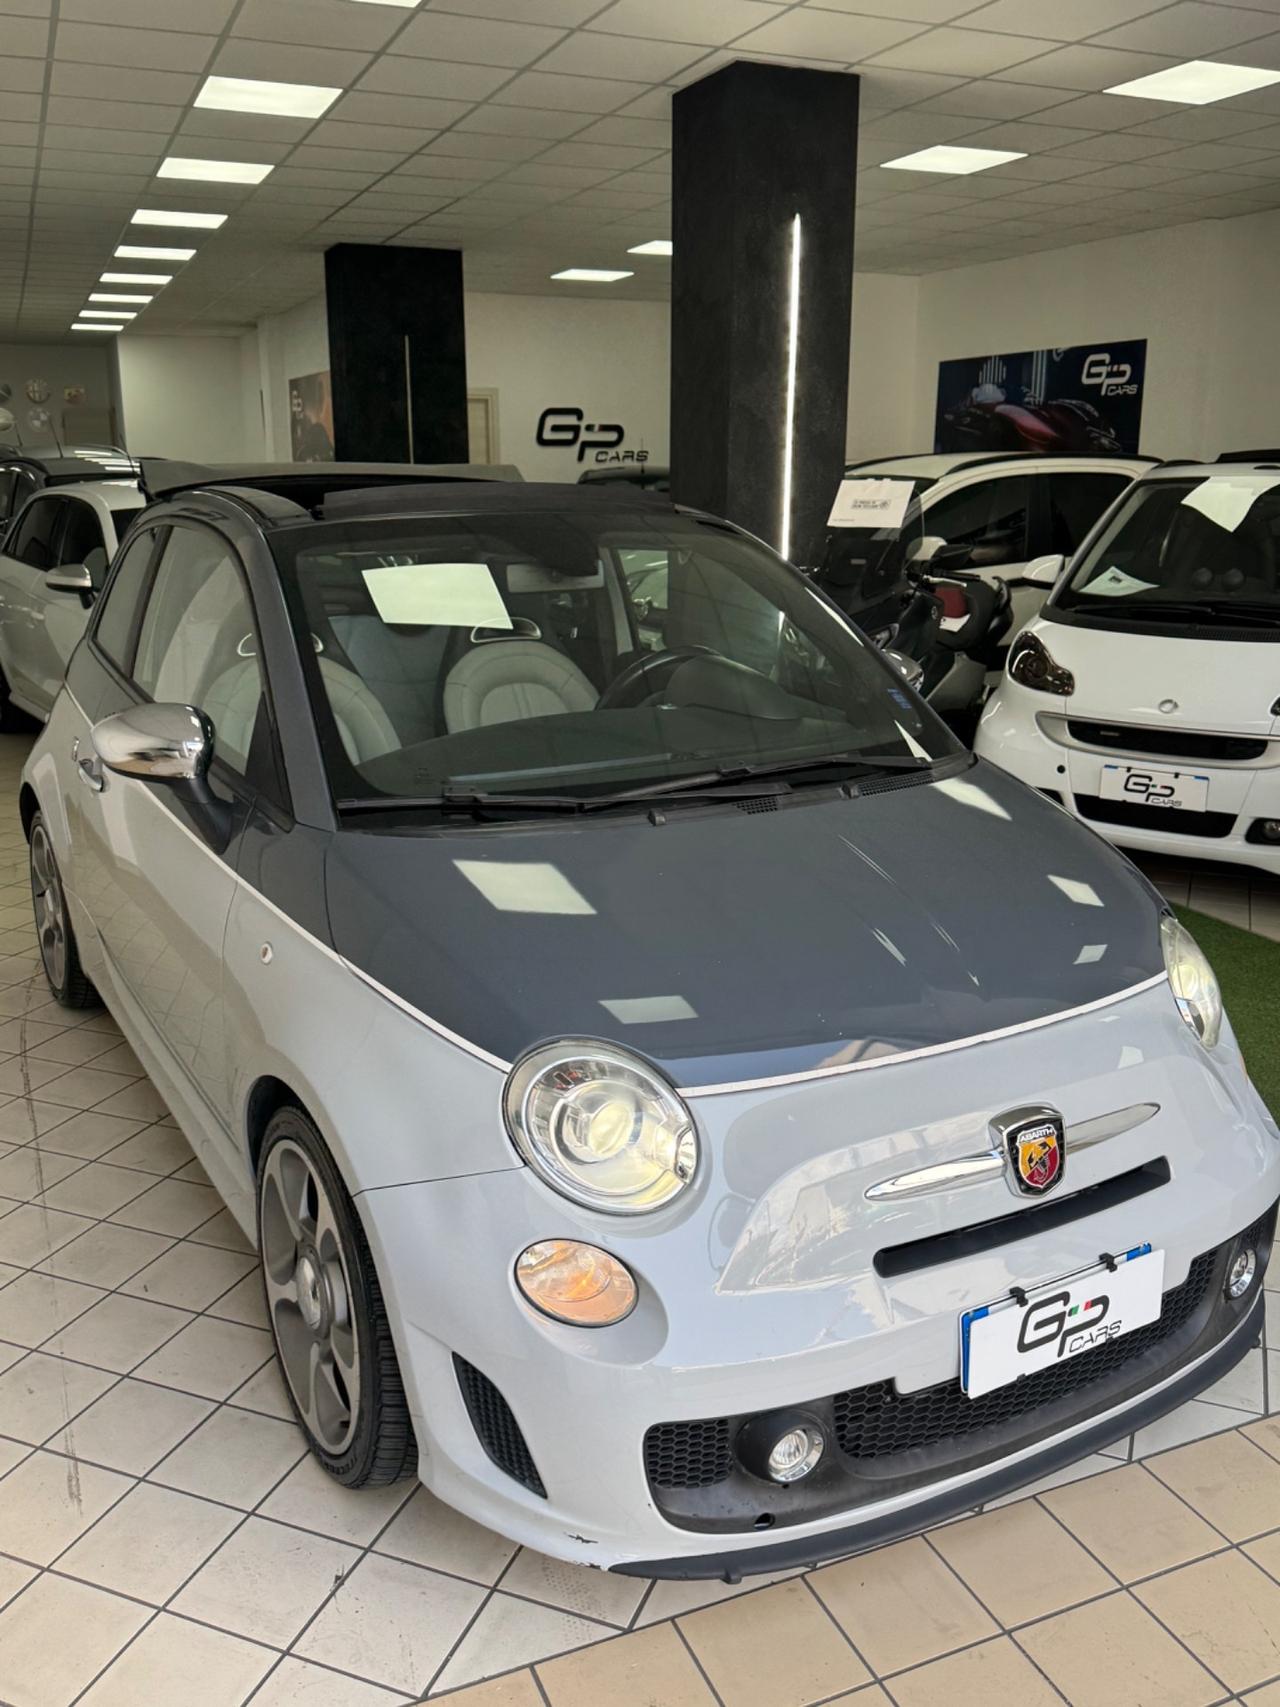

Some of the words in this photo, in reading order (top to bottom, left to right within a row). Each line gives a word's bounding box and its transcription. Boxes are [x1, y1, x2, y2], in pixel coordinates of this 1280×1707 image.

[1107, 384, 1138, 396] CARS
[536, 408, 624, 463] GP
[595, 451, 649, 463] CARS
[1124, 773, 1175, 802] GP
[1150, 797, 1182, 806] CARS
[1020, 1127, 1054, 1141] ABARTH
[1017, 1291, 1110, 1357] GP
[1069, 1320, 1122, 1353] CARS
